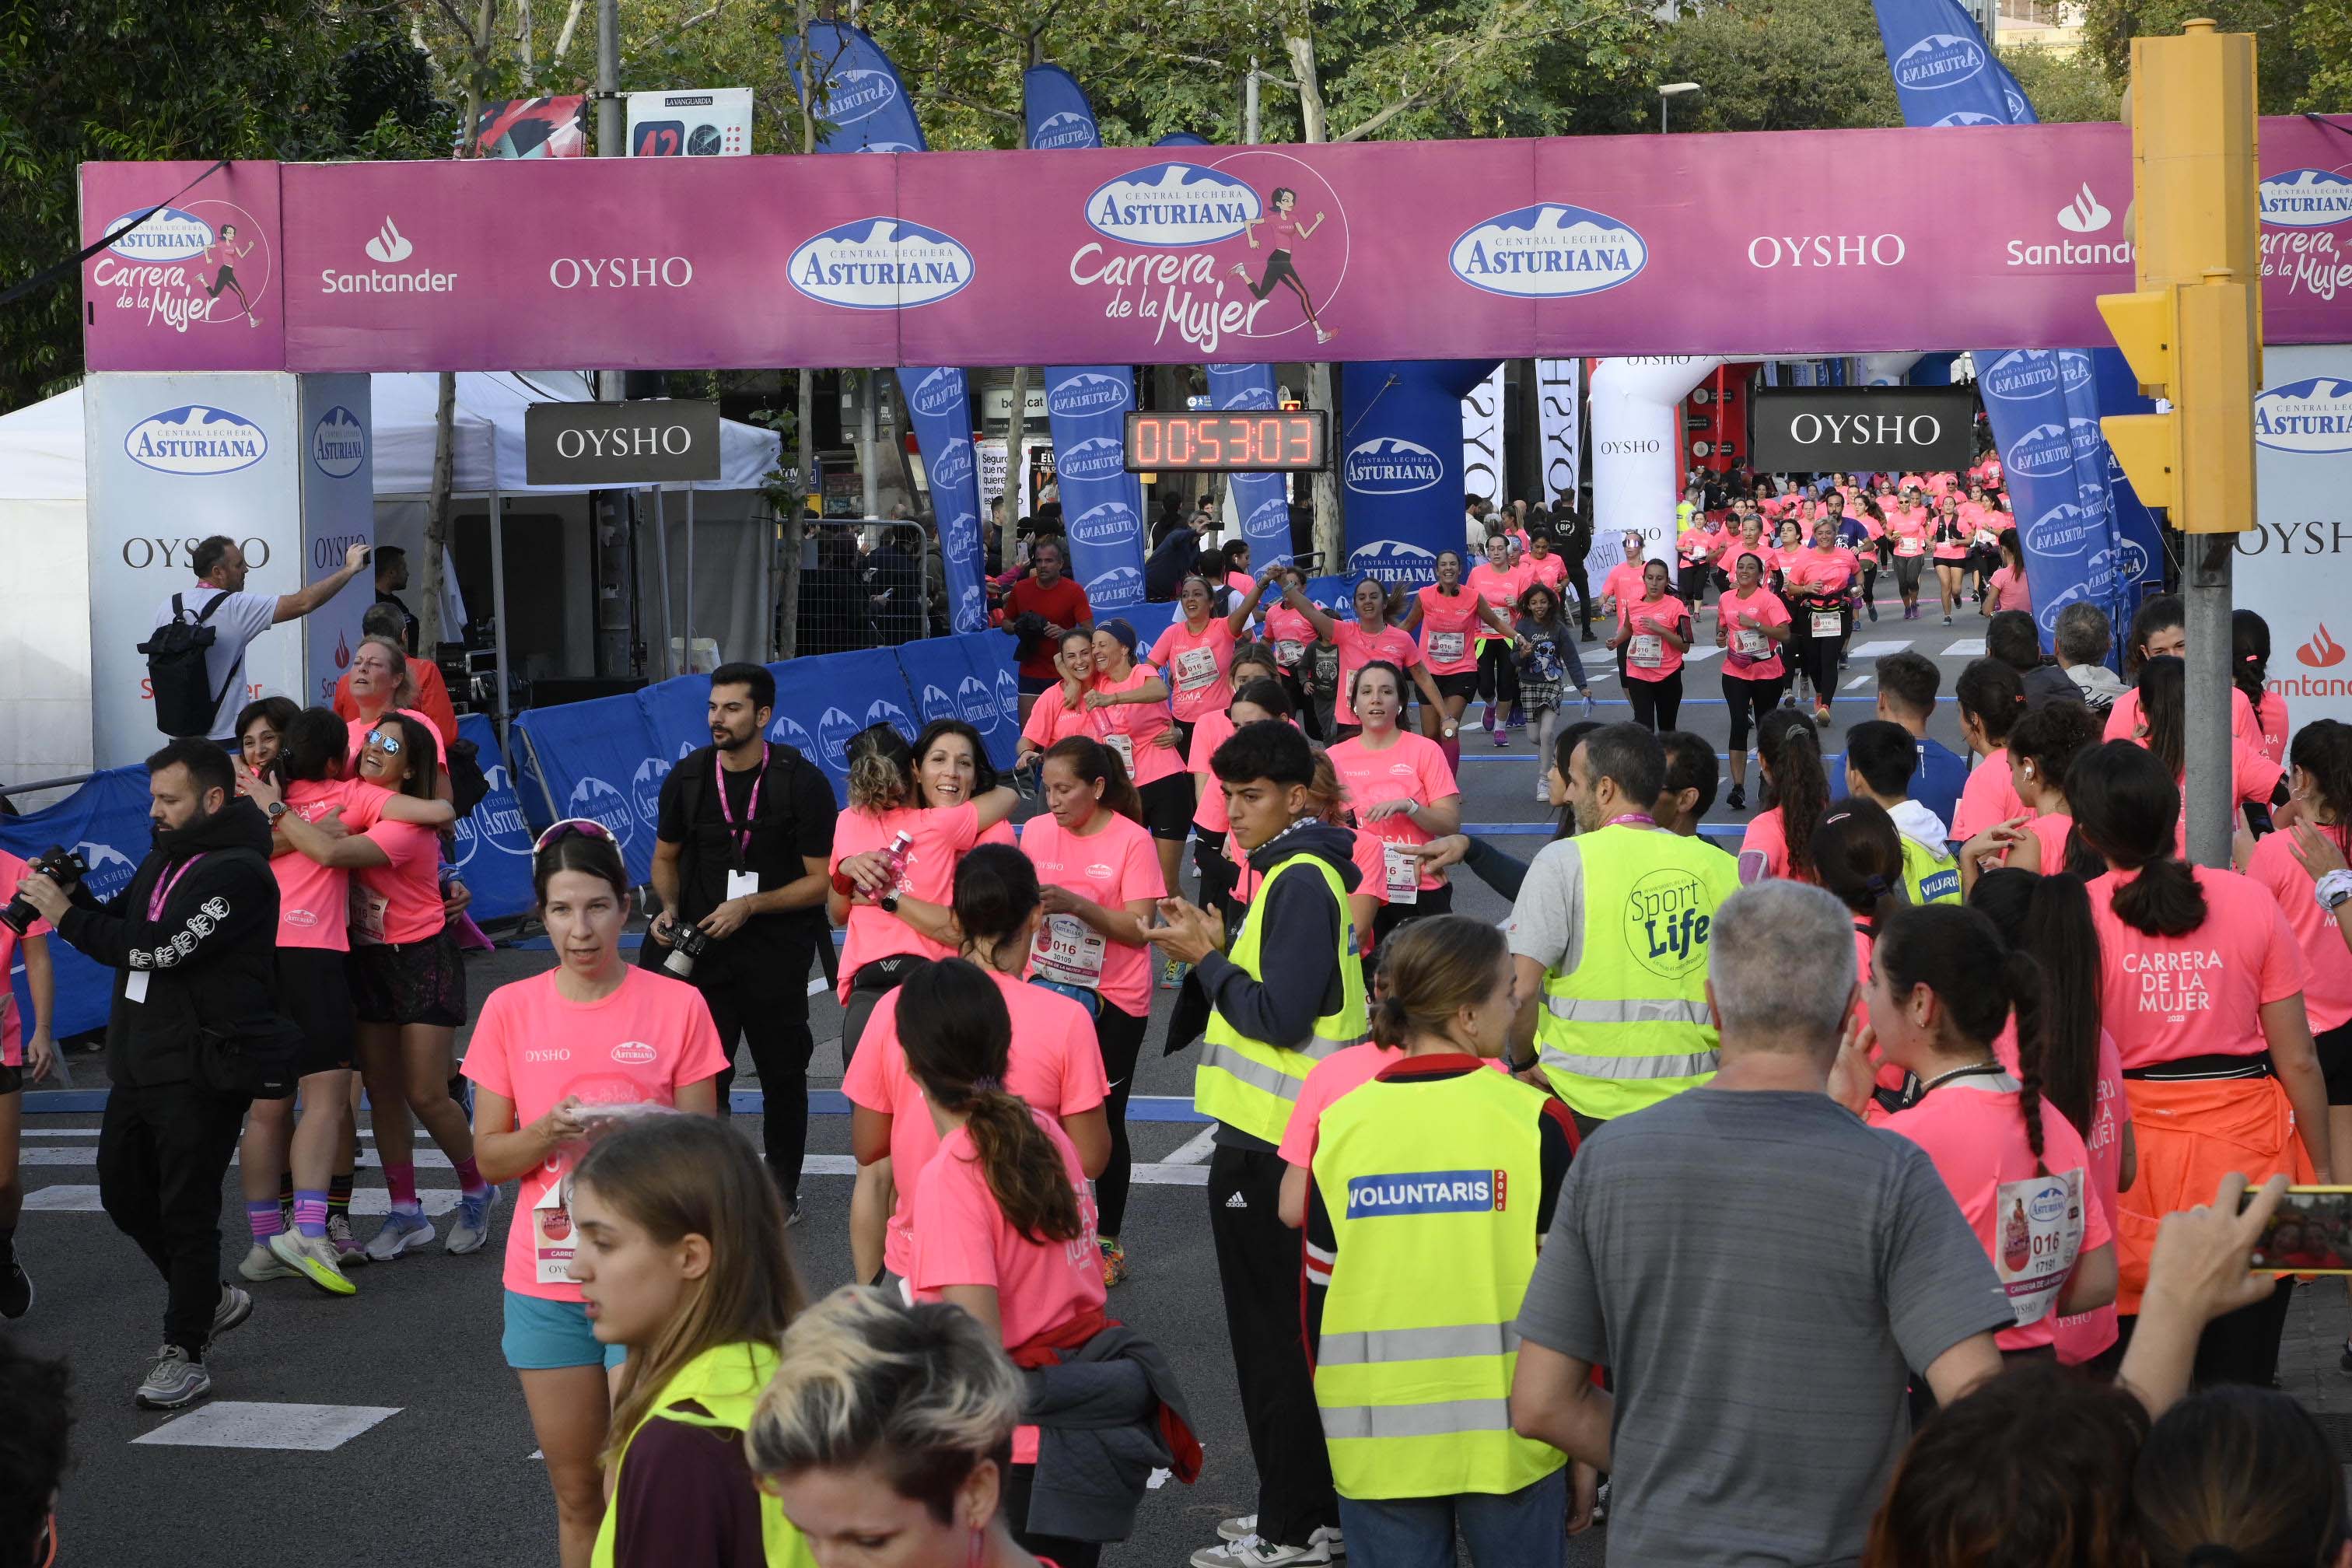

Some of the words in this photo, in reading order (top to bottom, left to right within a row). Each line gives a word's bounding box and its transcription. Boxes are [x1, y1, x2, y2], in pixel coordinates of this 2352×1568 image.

[1125, 191, 1181, 200] CENTRAL
[1186, 190, 1242, 199] LECHERA
[1098, 194, 1249, 226] ASTURIANA
[1495, 236, 1556, 247] CENTRAL
[1563, 233, 1626, 244] LECHERA
[1748, 233, 1906, 268] OYSHO
[2007, 239, 2136, 266] Santand
[2260, 231, 2334, 254] arrera
[830, 249, 888, 258] CENTRAL
[894, 248, 954, 257] LECHERA
[1069, 242, 1216, 286] Carrera
[1464, 239, 1633, 275] ASTURIANA
[2278, 255, 2293, 276] la
[94, 257, 187, 287] Carrera
[321, 269, 458, 294] Santander
[549, 256, 693, 289] OYSHO
[801, 252, 961, 286] ASTURIANA
[2288, 250, 2352, 301] Muje
[116, 289, 134, 309] de
[137, 288, 149, 310] la
[147, 285, 220, 334] Mujer
[1105, 289, 1133, 318] de
[1139, 285, 1158, 317] la
[1153, 280, 1270, 353] Mujer
[556, 425, 691, 458] OYSHO
[1138, 419, 1311, 463] 00:53:03
[1790, 414, 1941, 445] OYSHO
[136, 432, 257, 457] ASTURIANA
[317, 429, 362, 461] ASTURIANA
[1600, 439, 1661, 455] OYSHO
[982, 467, 996, 475] que
[1347, 459, 1436, 481] ASTURIANA
[122, 537, 270, 569] OYSO
[1531, 631, 1550, 646] Stitch
[1188, 663, 1202, 672] 016
[963, 702, 996, 723] ASTURIANA
[1631, 879, 1699, 922] Sport
[1644, 908, 1710, 961] Life
[1053, 940, 1077, 956] 016
[1053, 953, 1073, 964] 30109
[2122, 949, 2224, 973] CARRERA
[2142, 972, 2173, 992] DE
[2179, 971, 2205, 990] LA
[2138, 991, 2210, 1013] MUJER
[2167, 1014, 2185, 1023] 2023
[526, 1048, 570, 1062] OYSHO
[614, 1050, 653, 1059] ASTURIANA
[1349, 1181, 1489, 1209] VOLUNTARIS
[2033, 1231, 2060, 1255] 016
